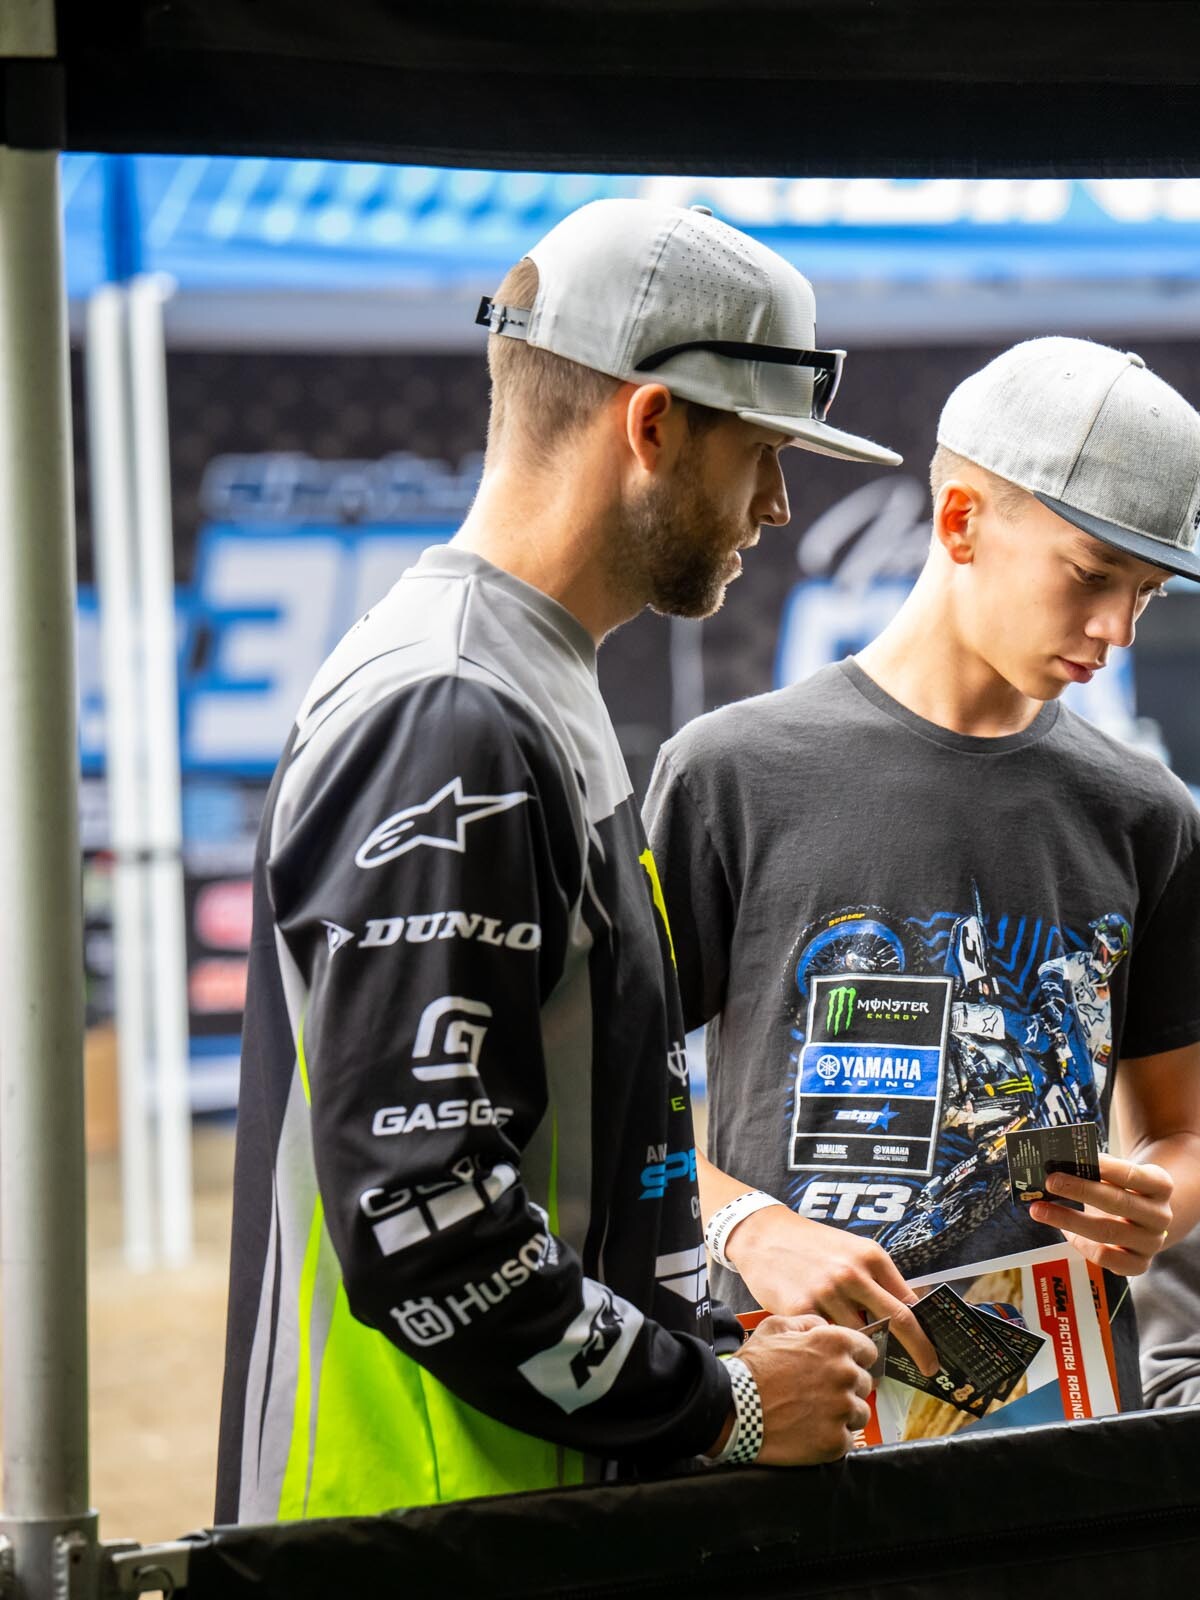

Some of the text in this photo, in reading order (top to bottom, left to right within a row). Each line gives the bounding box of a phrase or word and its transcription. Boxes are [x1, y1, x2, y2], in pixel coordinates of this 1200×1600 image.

[857, 998, 930, 1014] MONSTER
[867, 1013, 918, 1021] ENERGY
[841, 1056, 922, 1081] YAMAHA
[824, 1080, 915, 1088] RACING
[798, 1181, 913, 1222] ET3
[1058, 1316, 1077, 1371] FACTORY
